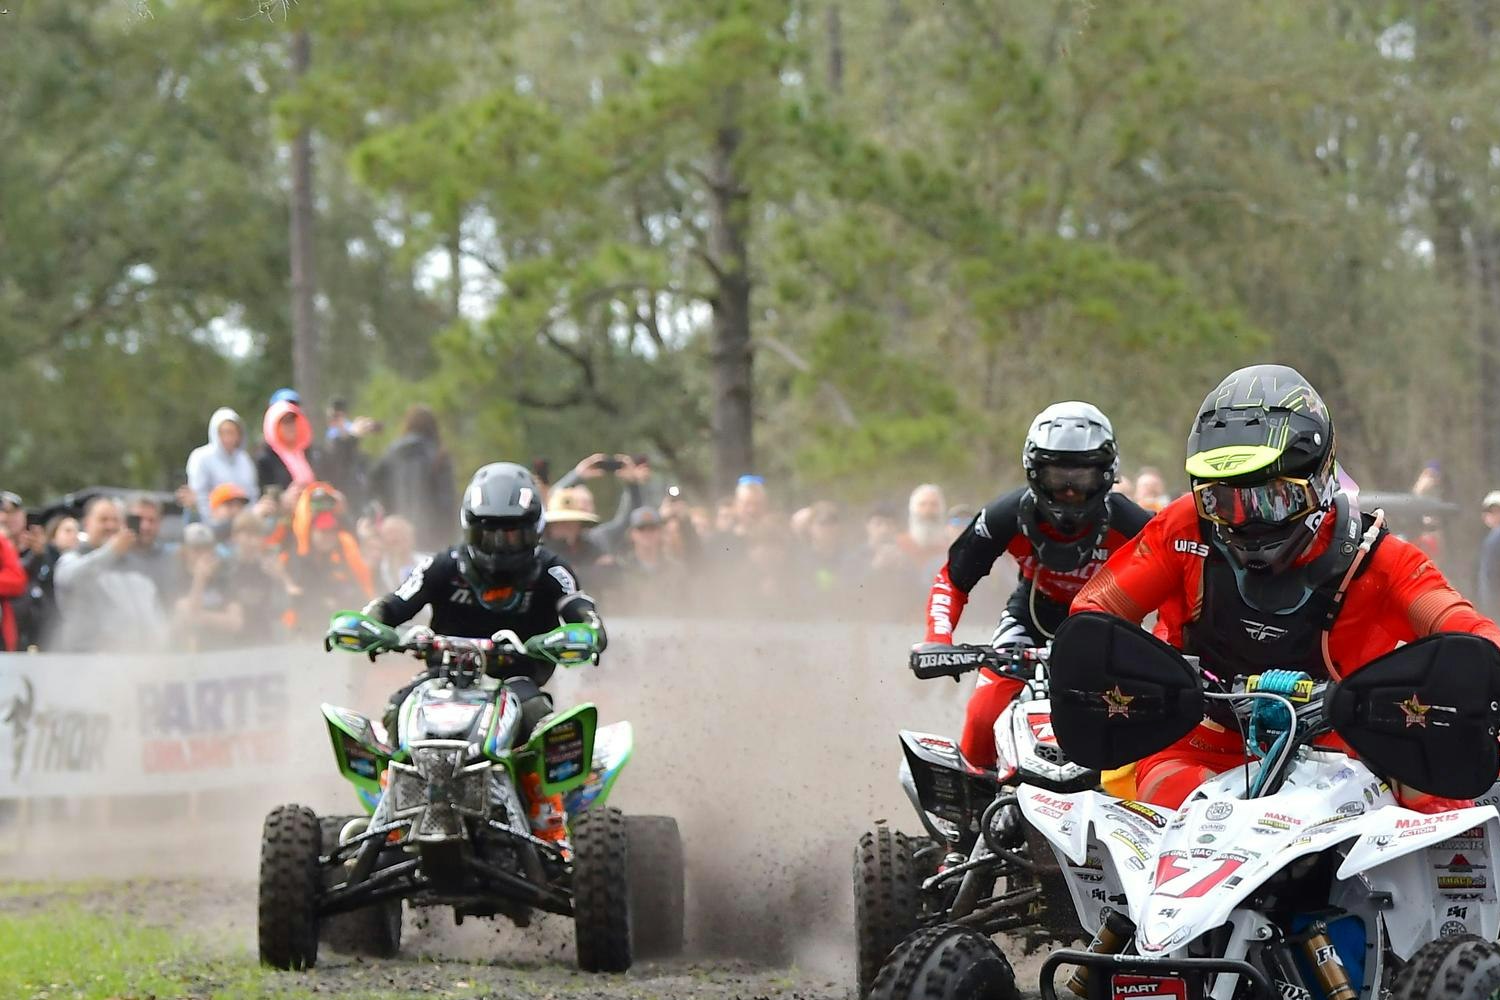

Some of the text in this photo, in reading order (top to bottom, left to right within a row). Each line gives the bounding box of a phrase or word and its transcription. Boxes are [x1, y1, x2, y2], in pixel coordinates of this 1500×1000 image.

[1174, 538, 1210, 558] WPS
[1395, 812, 1460, 829] MAXXIS
[1116, 984, 1158, 994] HART
